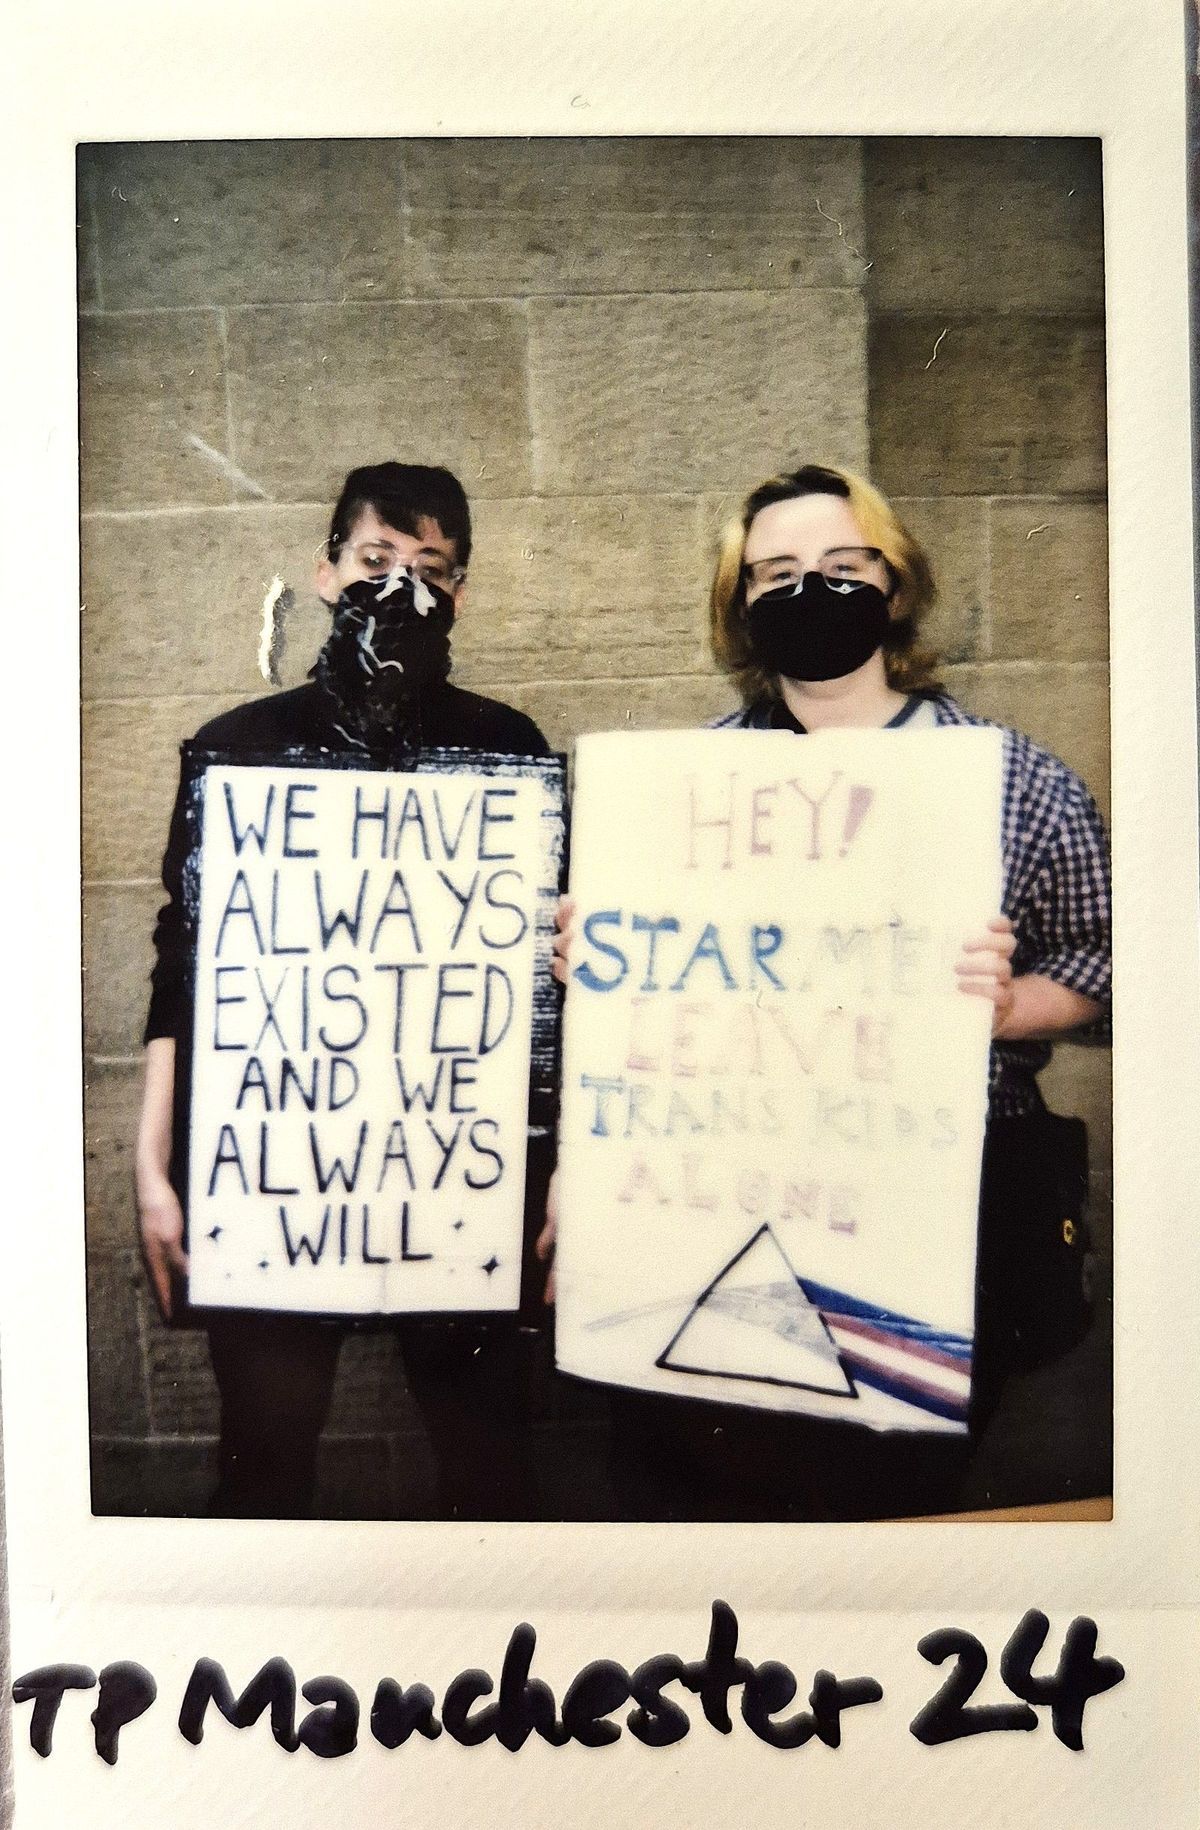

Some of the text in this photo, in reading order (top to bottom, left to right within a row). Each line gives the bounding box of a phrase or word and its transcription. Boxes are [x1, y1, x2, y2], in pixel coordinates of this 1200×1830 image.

[222, 781, 518, 862] WE HAVE
[684, 770, 877, 871] HEY!
[213, 867, 530, 959] ALWAYS
[212, 961, 516, 1057] EXISTED
[234, 1055, 482, 1115] AND WE
[580, 1072, 785, 1139] TRANS
[206, 1117, 507, 1198] ALWAYS
[617, 1150, 860, 1236] ALONE
[278, 1201, 436, 1267] WILL
[12, 1599, 1126, 1765] TP Manchester 24
